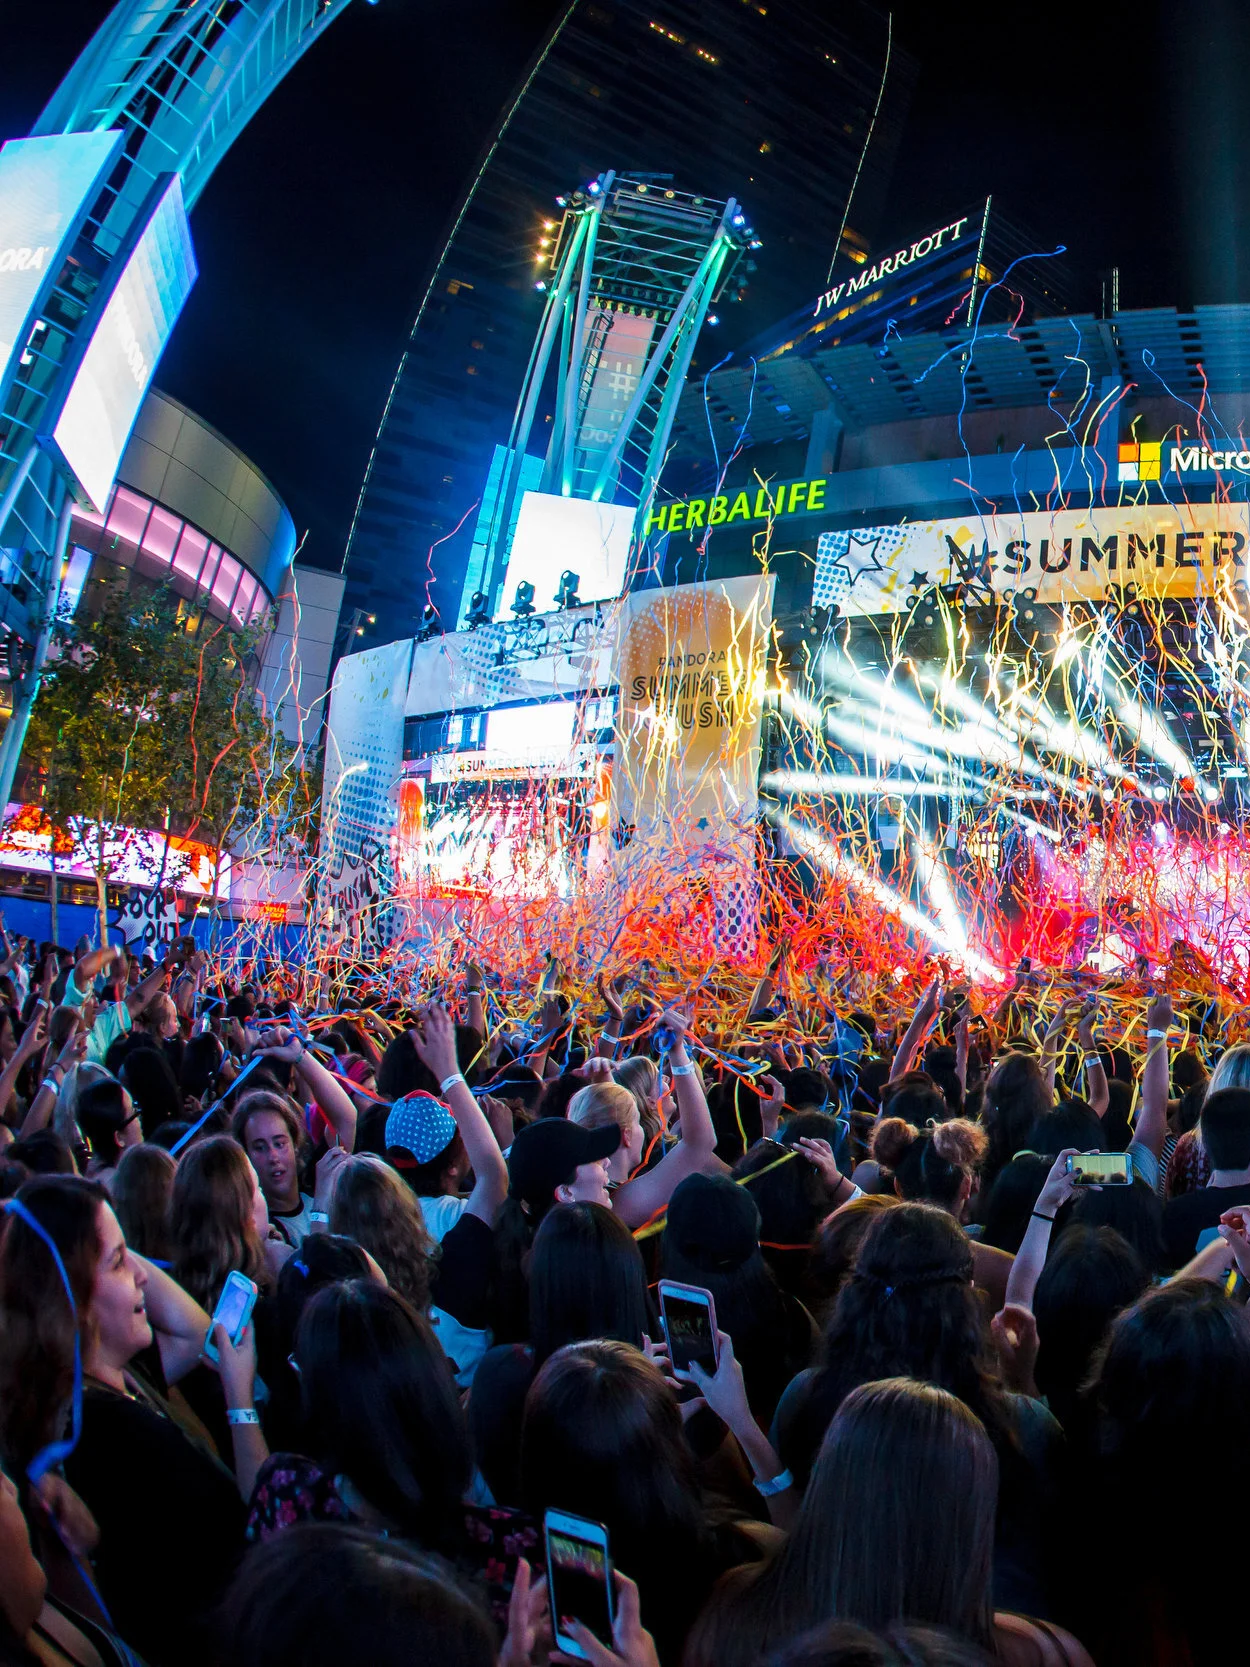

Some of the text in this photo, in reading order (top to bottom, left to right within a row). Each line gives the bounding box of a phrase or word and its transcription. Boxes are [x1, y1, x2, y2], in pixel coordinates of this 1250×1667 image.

[813, 216, 968, 317] JW MARRIOTT
[645, 479, 827, 536] HERBALIFE
[658, 650, 726, 669] PANDORA
[631, 668, 749, 701] SUMMER
[643, 701, 735, 731] USH
